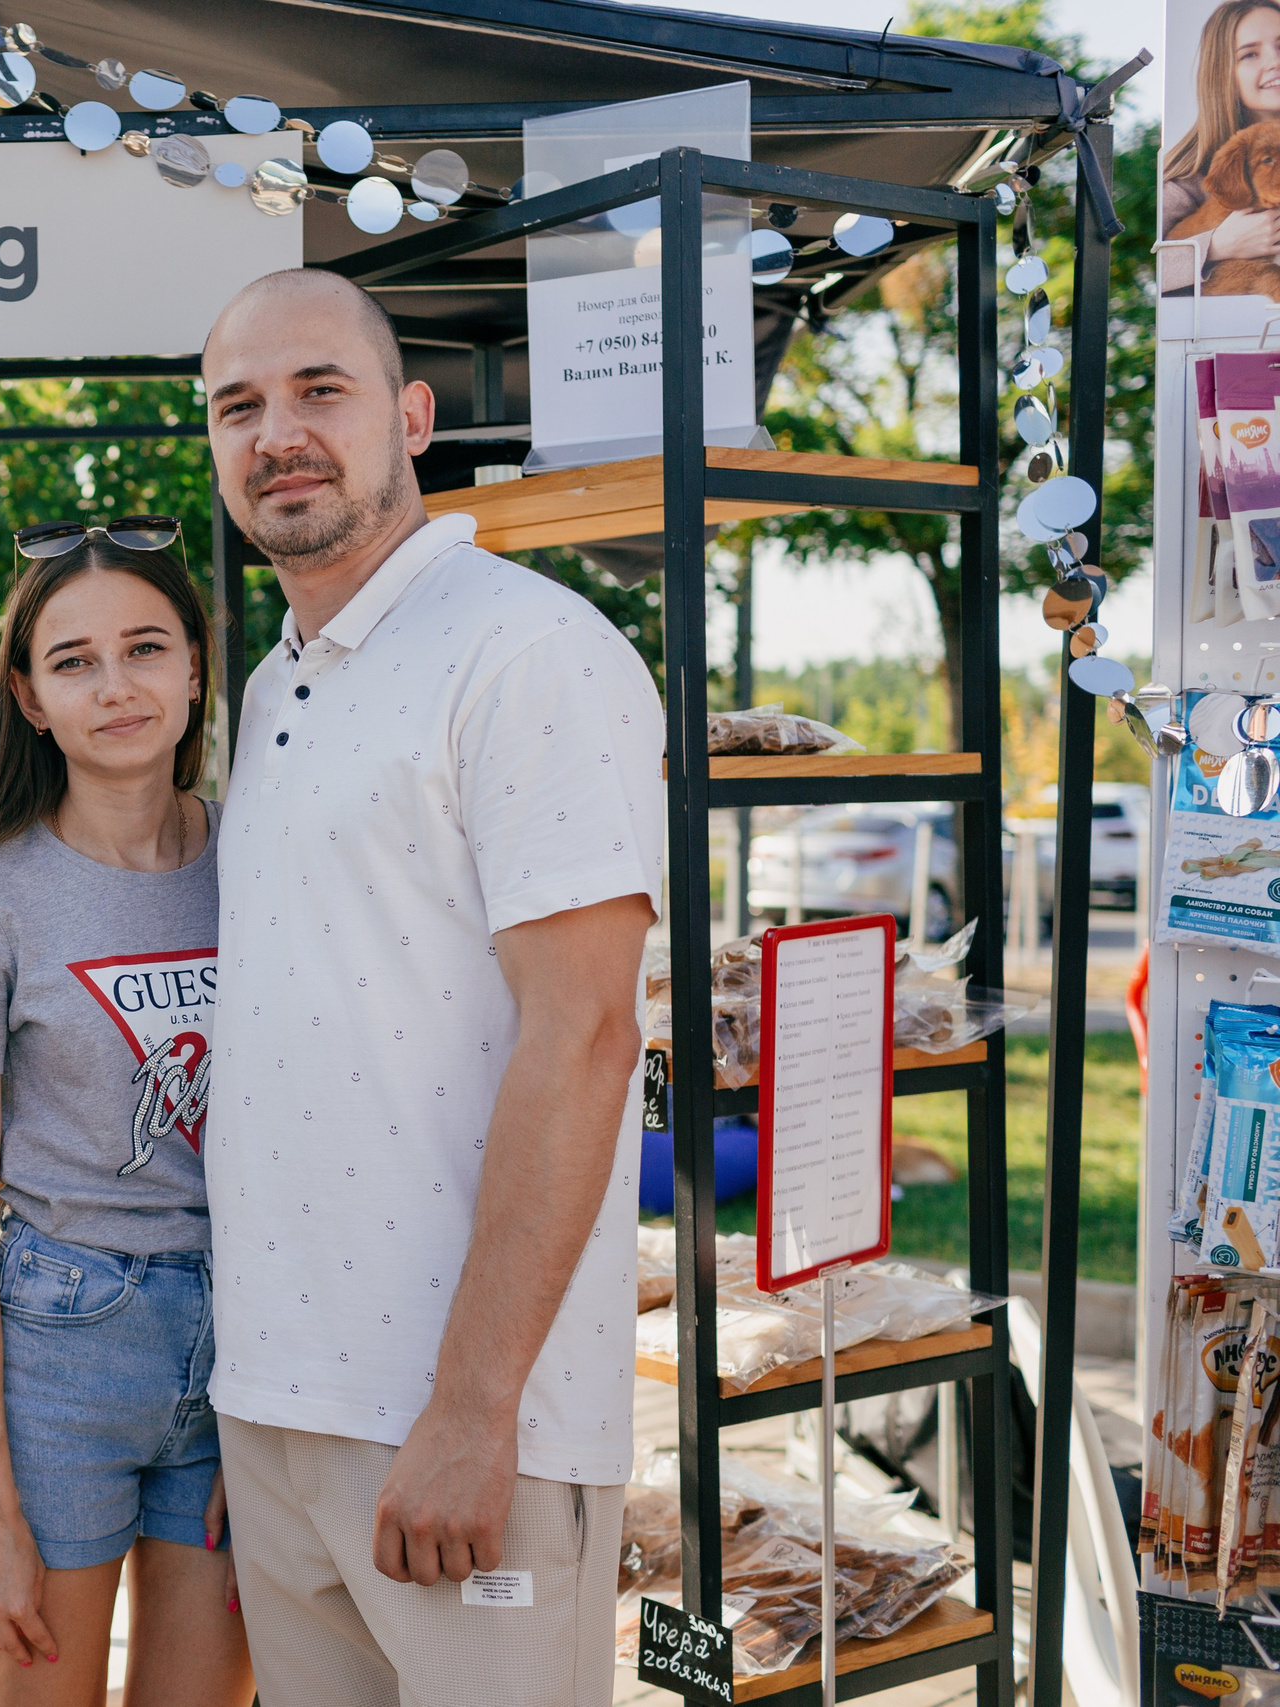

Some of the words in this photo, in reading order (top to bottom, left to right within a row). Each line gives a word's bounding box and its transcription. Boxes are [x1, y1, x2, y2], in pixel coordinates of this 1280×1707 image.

[577, 299, 615, 313] Номер
[616, 296, 637, 308] для
[575, 339, 594, 354] +7
[598, 333, 637, 355] (950)
[563, 366, 614, 382] Вадим
[715, 350, 733, 365] К.
[1185, 899, 1227, 911] ЛАКОМСТВО
[1227, 906, 1244, 914] ДЛЯ
[1244, 908, 1274, 918] СОБАК
[1188, 911, 1227, 923] КРУЧЕНЫЕ
[1227, 917, 1267, 929] ПАЛОЧКИ
[688, 1613, 727, 1650] 300р.
[1180, 1668, 1234, 1690] МНЯМС
